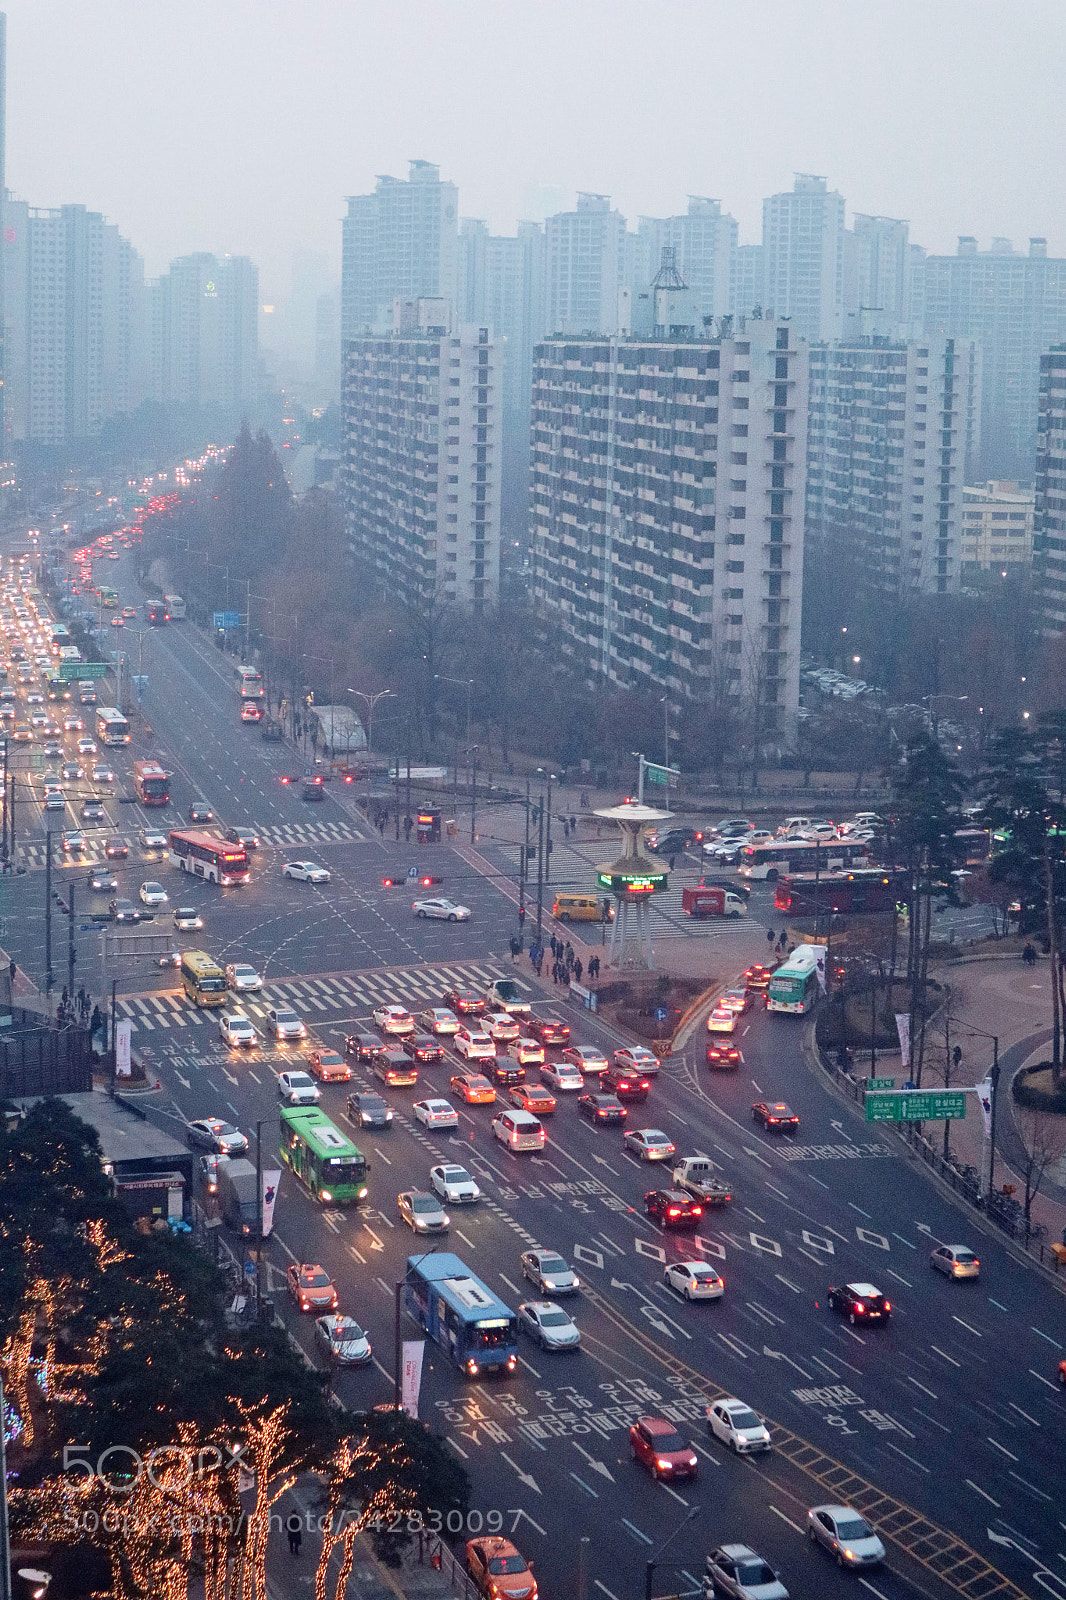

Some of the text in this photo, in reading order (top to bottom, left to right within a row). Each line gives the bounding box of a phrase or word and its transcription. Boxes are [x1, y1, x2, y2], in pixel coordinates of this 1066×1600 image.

[558, 1383, 635, 1409] 공원
[626, 1376, 703, 1402] 공원
[790, 1385, 866, 1408] 백화점
[435, 1397, 489, 1423] 전용
[822, 1410, 898, 1435] 호텔
[454, 1420, 514, 1446] 버스
[517, 1411, 592, 1440] 올림픽
